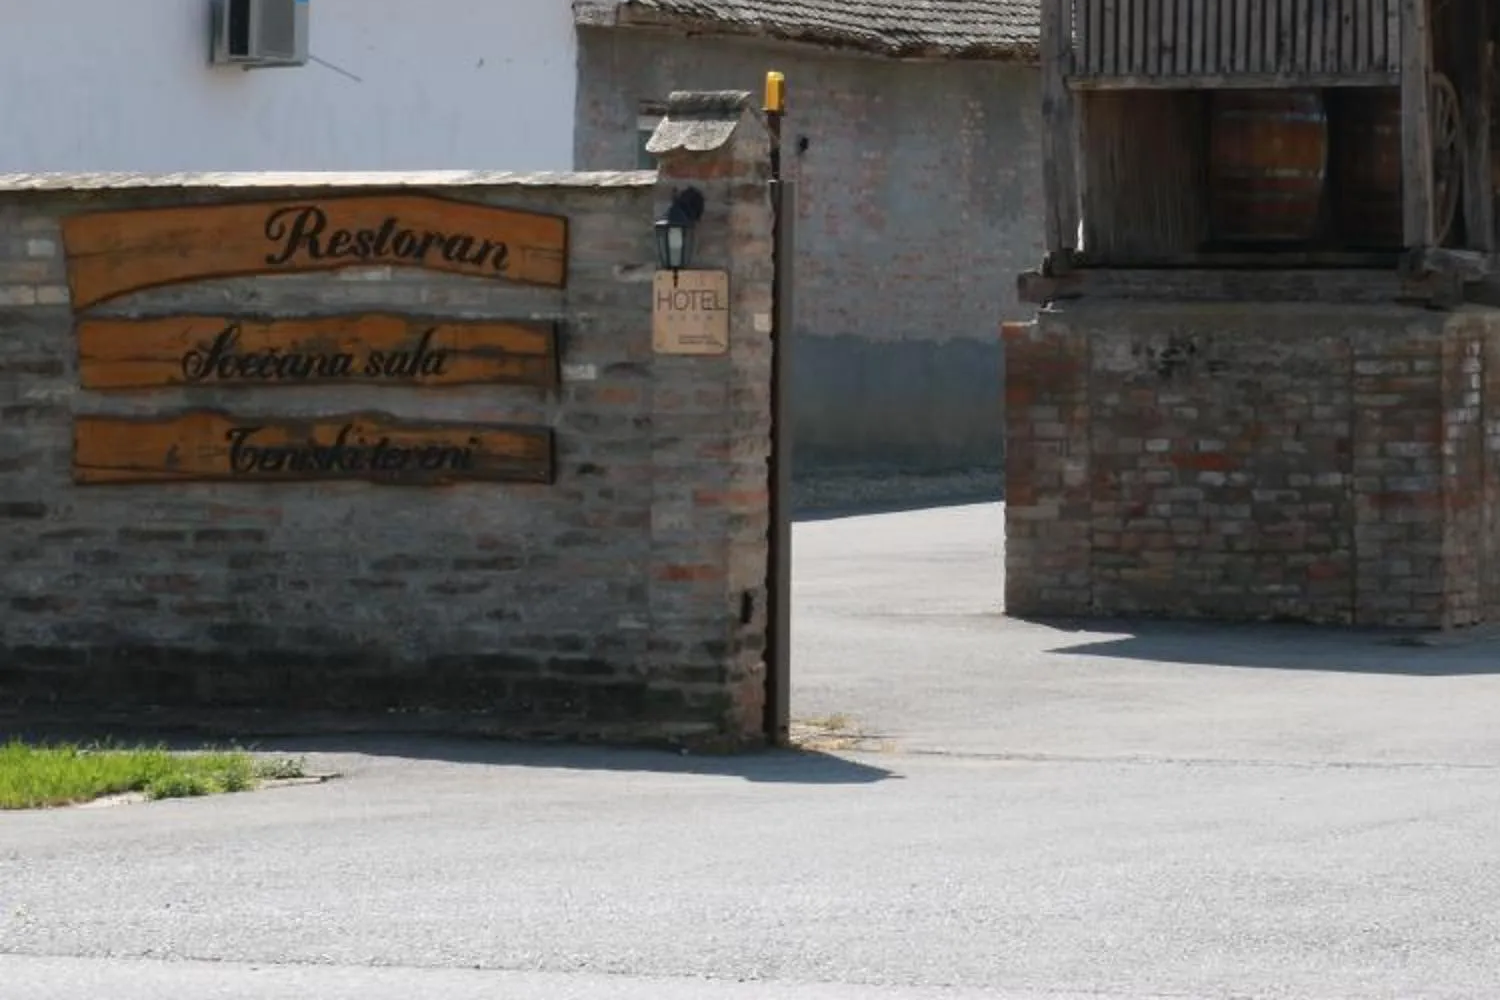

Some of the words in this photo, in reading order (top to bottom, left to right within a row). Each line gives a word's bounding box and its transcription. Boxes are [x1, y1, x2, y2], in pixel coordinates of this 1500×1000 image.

[264, 206, 511, 271] Restoran
[657, 289, 729, 312] HOTEL
[363, 327, 449, 378] sala
